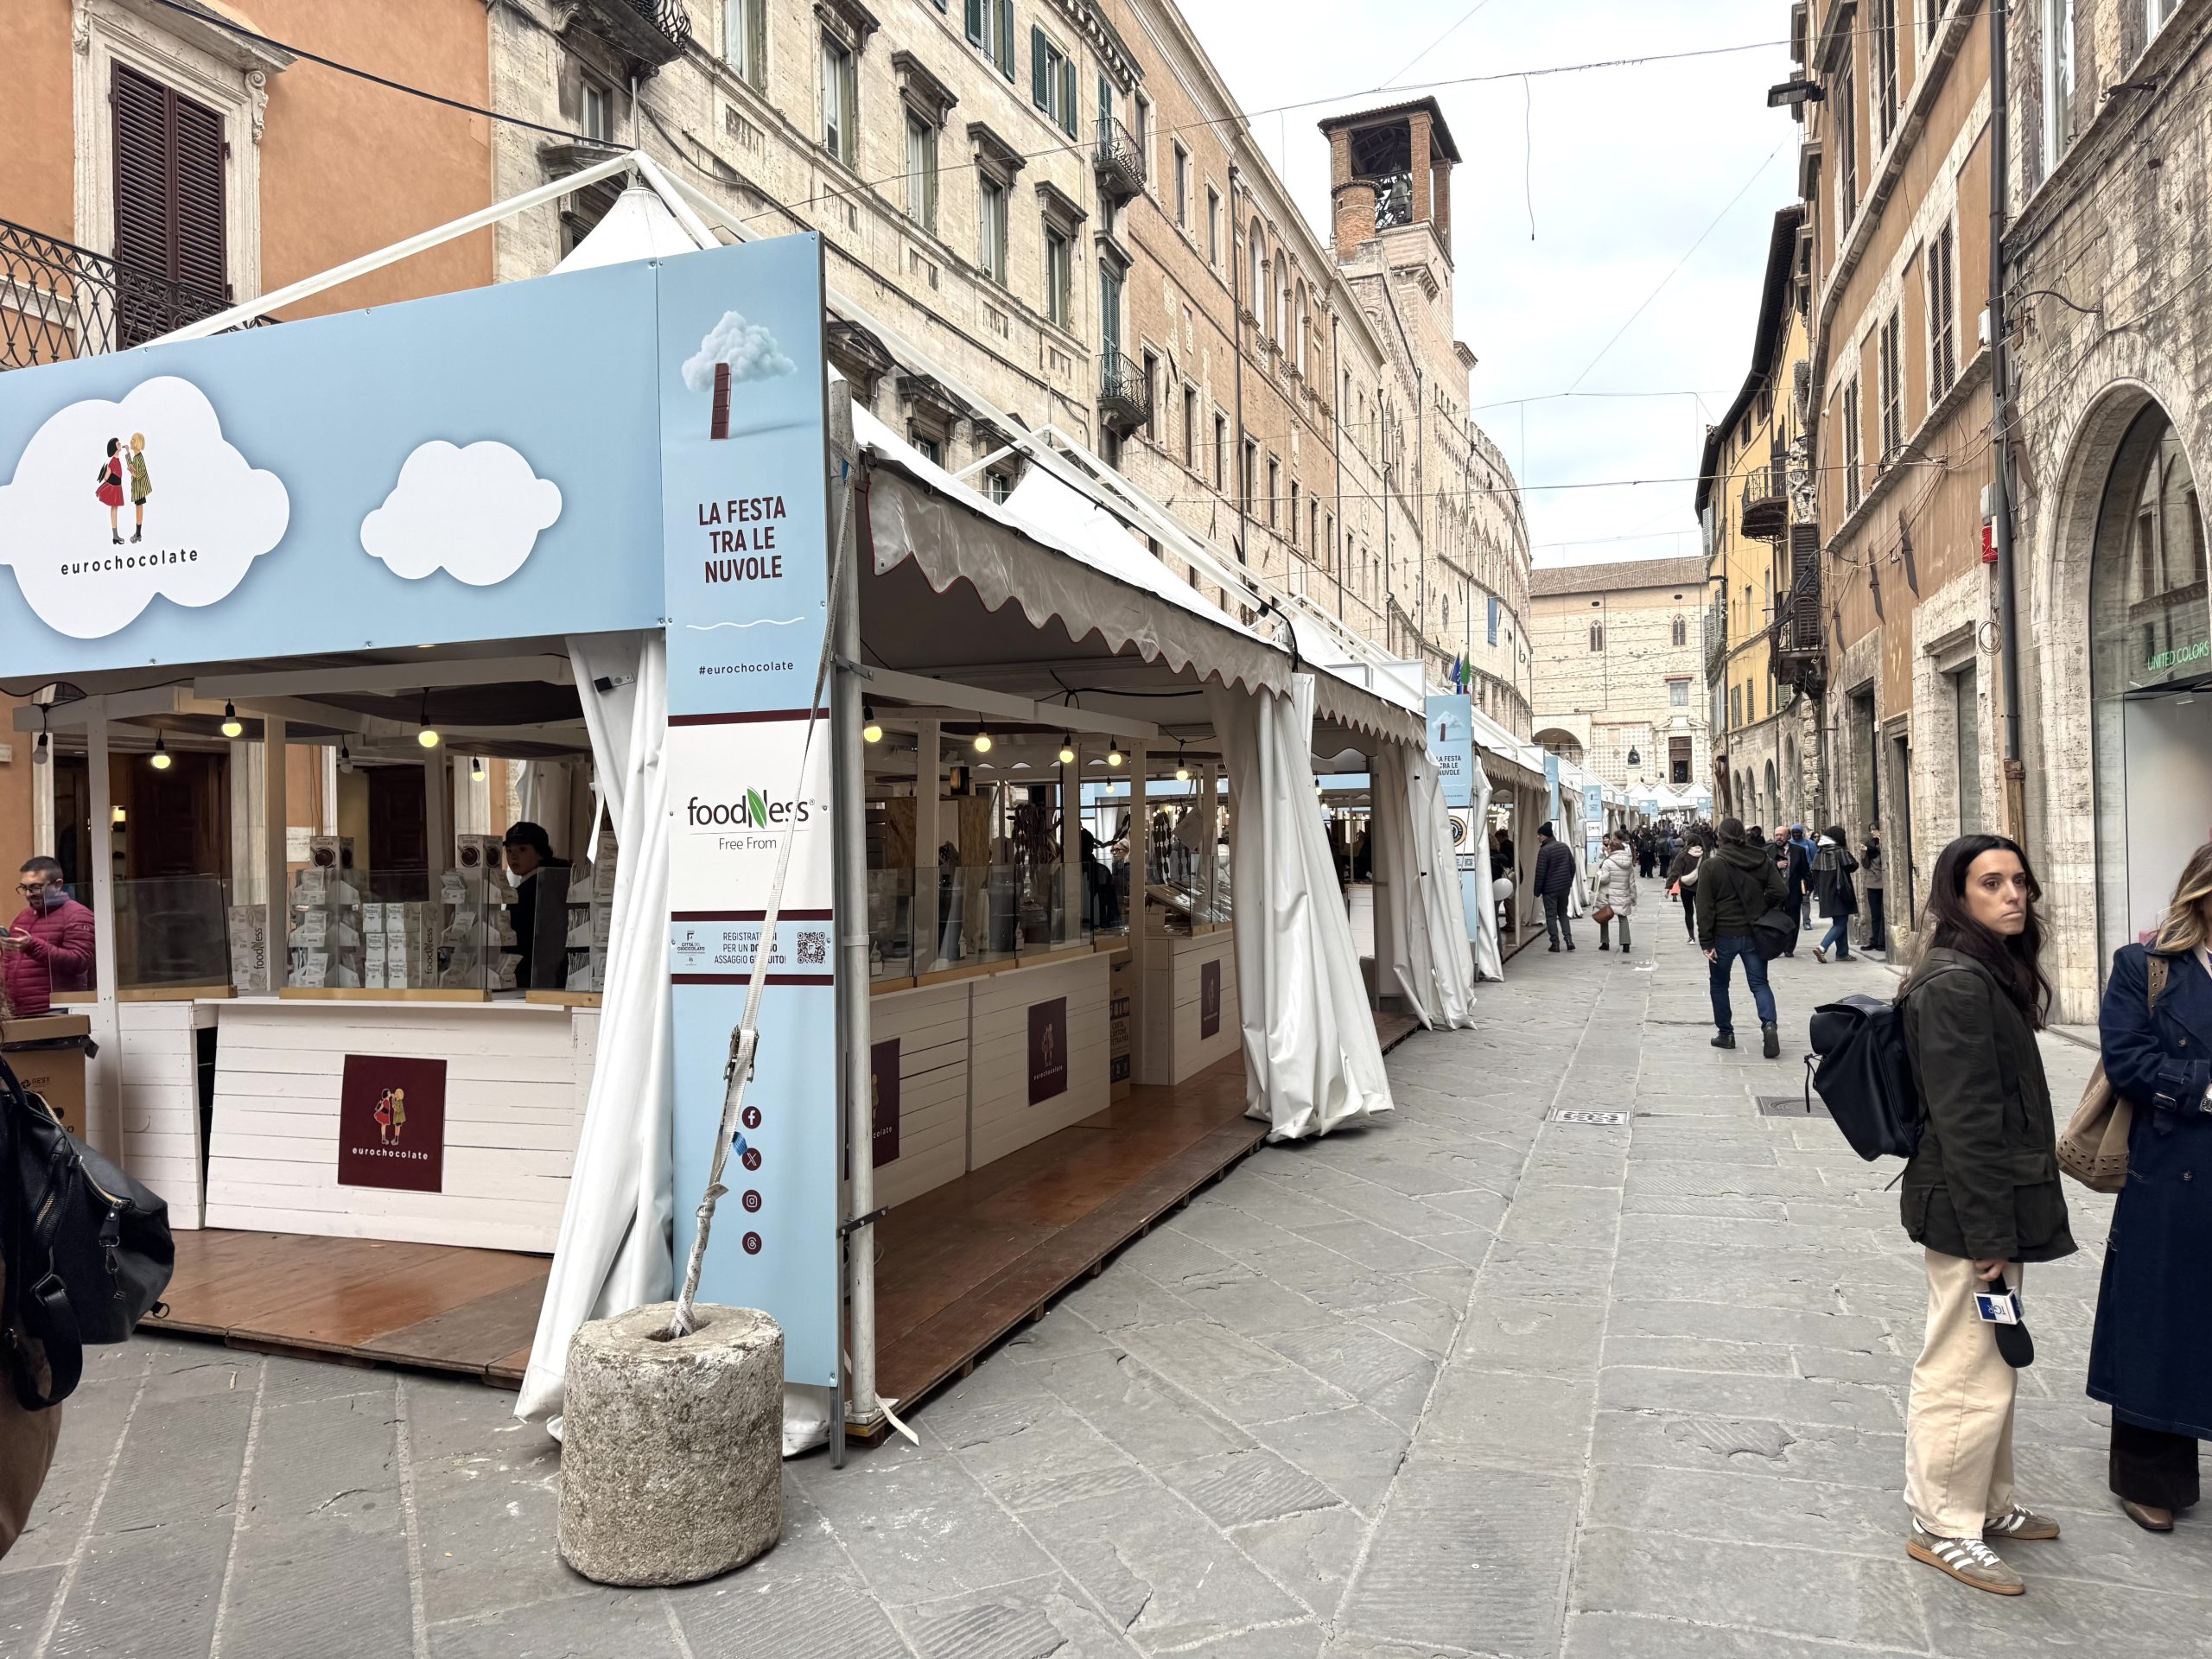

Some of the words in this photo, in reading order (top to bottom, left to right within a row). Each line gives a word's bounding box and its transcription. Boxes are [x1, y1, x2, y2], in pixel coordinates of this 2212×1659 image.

[698, 502, 721, 525] LA
[727, 495, 786, 524] FESTA
[709, 529, 747, 554] TRA
[753, 526, 776, 550] LE
[60, 548, 198, 575] eurochocolate
[705, 555, 783, 583] NUVOLE
[2147, 651, 2176, 671] UNITED
[2177, 640, 2210, 664] COLORS
[698, 661, 794, 676] #eurochocolate
[718, 837, 744, 850] Free
[747, 836, 777, 849] From
[722, 944, 736, 952] PER
[738, 944, 748, 952] UN
[714, 955, 748, 964] ASSAGGIO
[352, 1147, 429, 1160] eurochocolate
